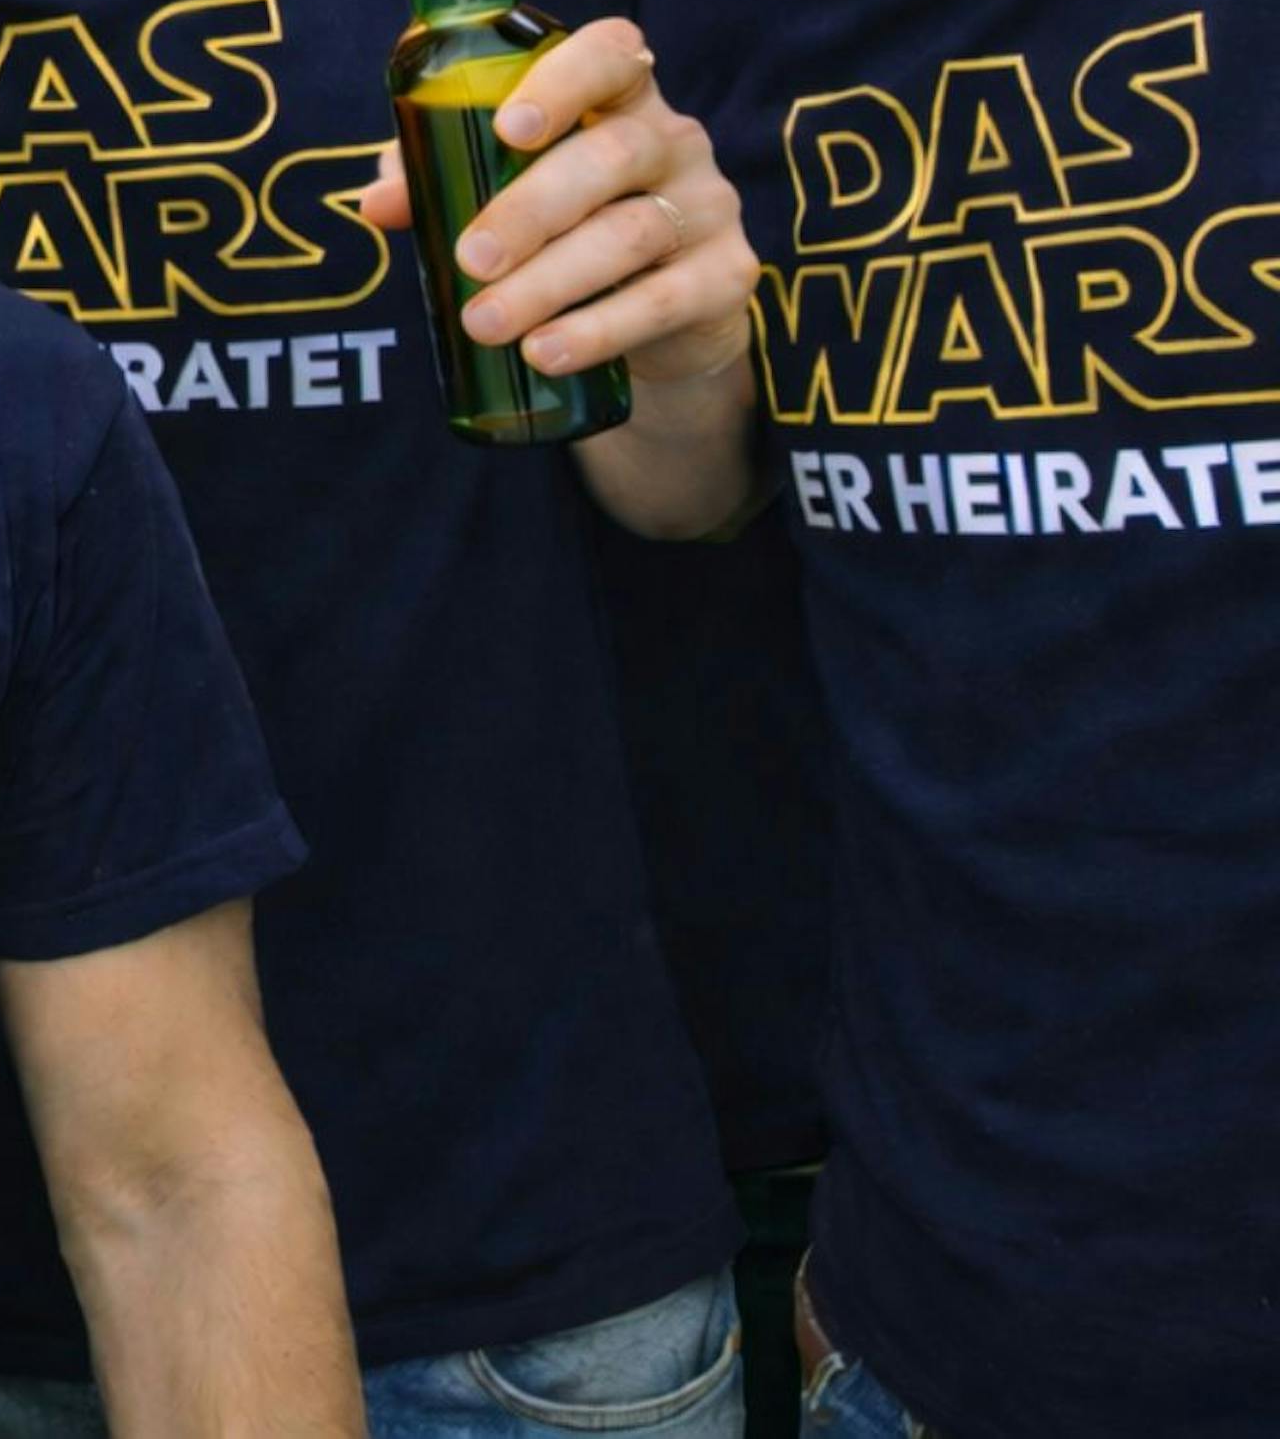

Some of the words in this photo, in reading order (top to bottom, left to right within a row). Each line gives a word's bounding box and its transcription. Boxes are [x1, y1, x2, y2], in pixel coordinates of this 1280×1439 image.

[784, 12, 1209, 253] DAS
[97, 328, 396, 413] RATET
[747, 205, 1280, 425] WARS
[790, 450, 881, 533] ER
[888, 440, 1280, 535] HEIRATE
